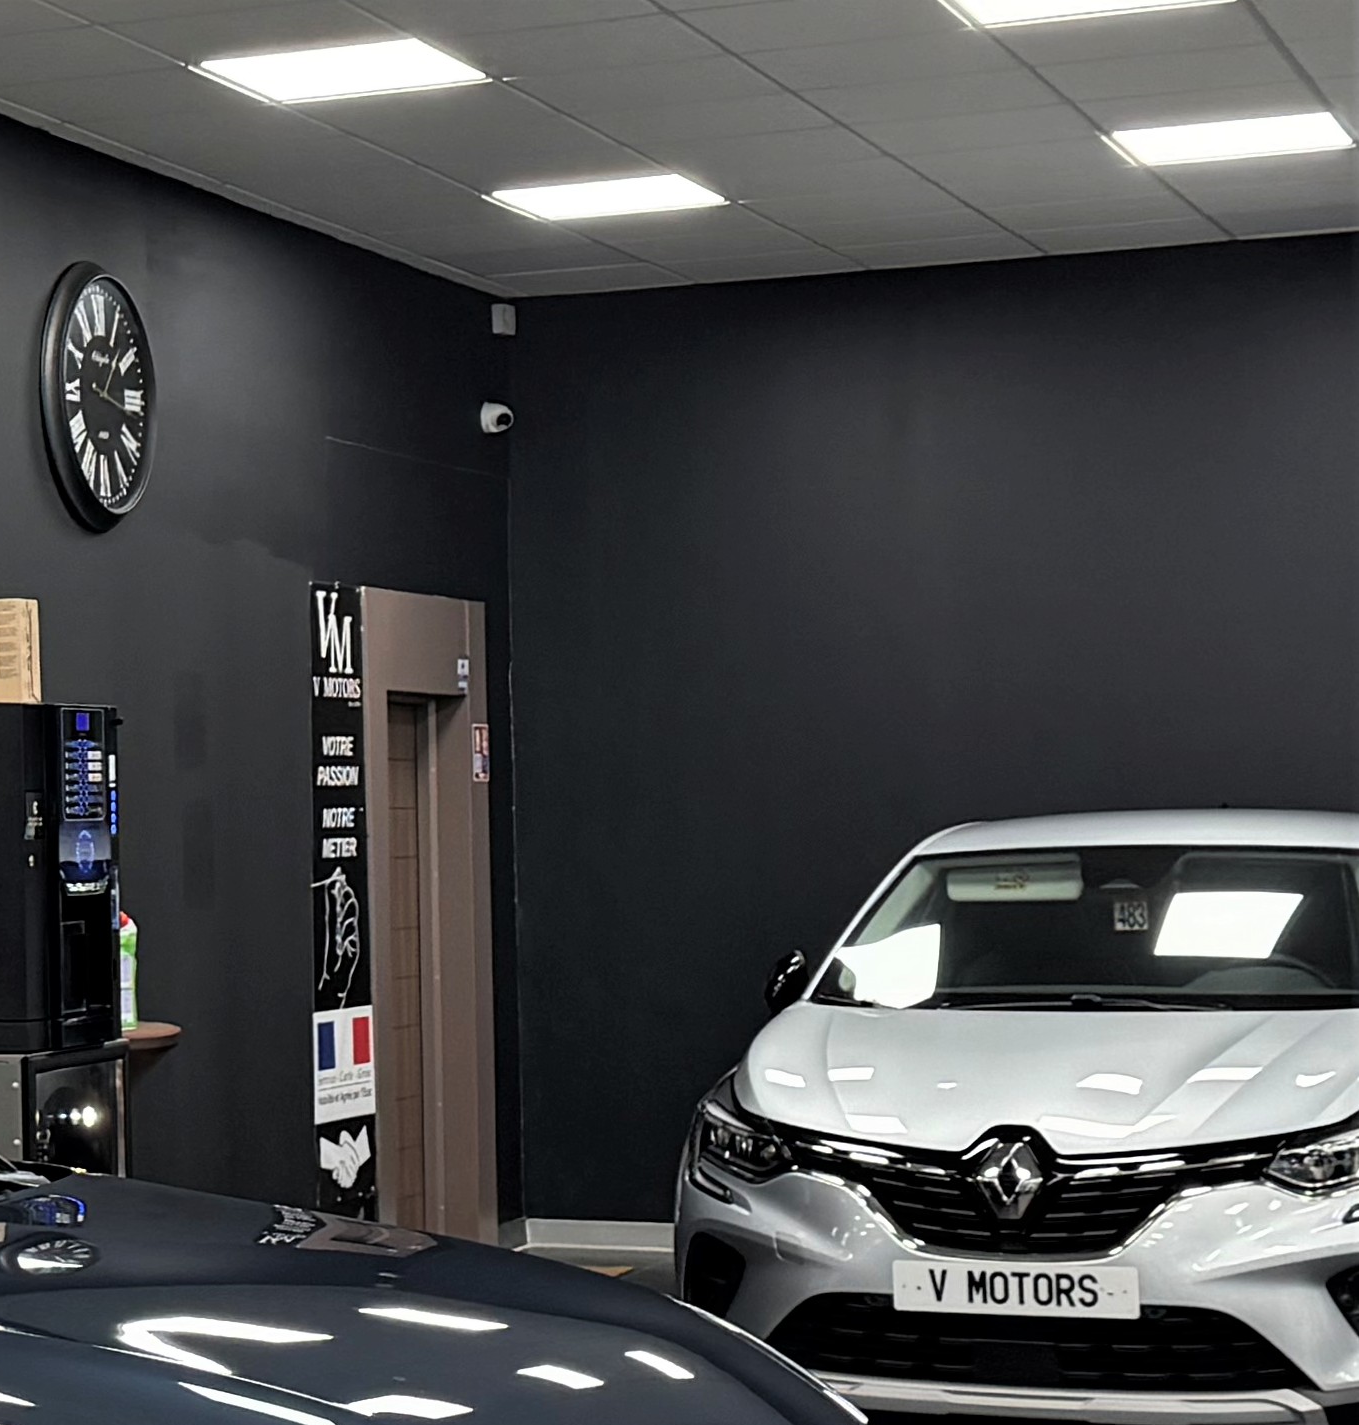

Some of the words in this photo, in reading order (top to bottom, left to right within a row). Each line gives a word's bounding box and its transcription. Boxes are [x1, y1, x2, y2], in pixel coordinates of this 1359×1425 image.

[312, 676, 321, 697] V
[323, 676, 361, 699] MOTORS
[322, 735, 355, 757] VOTRE
[316, 765, 360, 787] PASSION
[322, 807, 356, 828] NOTRE
[928, 1268, 948, 1302] V
[966, 1270, 1099, 1308] MOTORS
